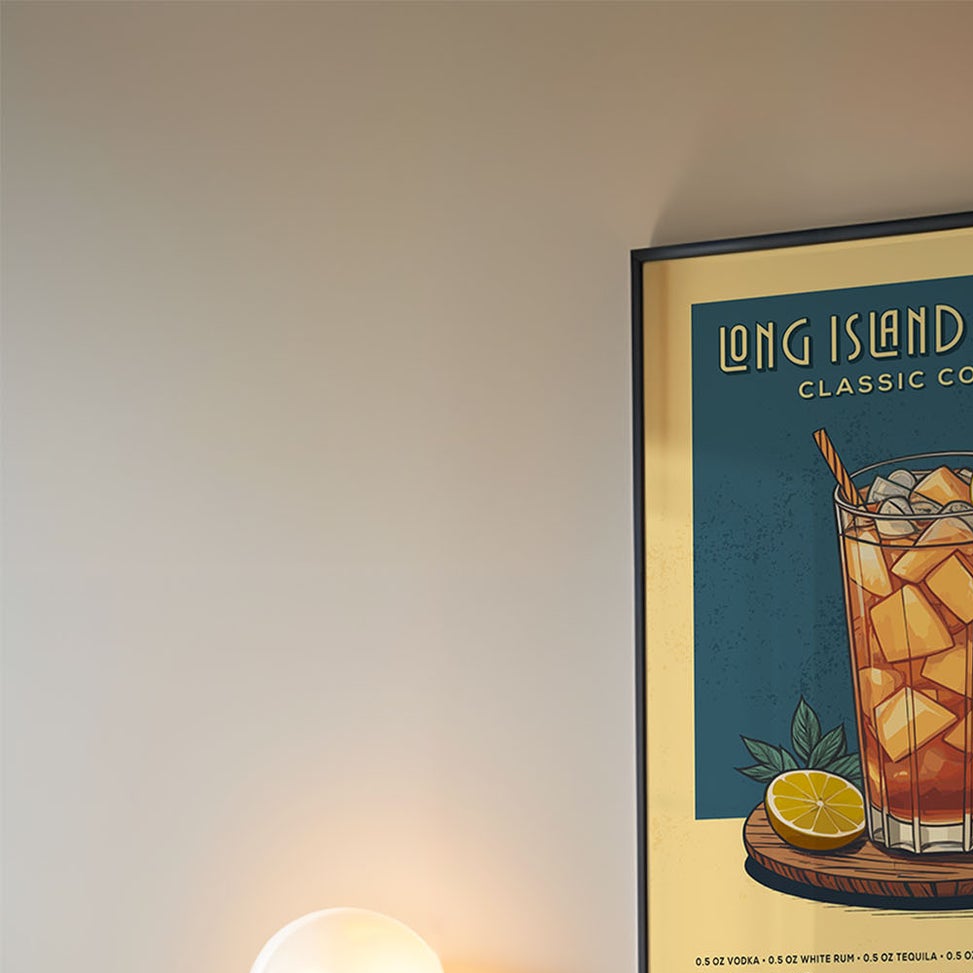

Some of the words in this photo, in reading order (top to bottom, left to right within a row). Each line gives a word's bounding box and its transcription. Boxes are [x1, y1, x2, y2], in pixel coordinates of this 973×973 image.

[720, 317, 810, 373] LONG
[831, 303, 965, 362] ISLAND
[798, 370, 925, 399] CLASSIC
[695, 957, 710, 966] 0.5
[712, 957, 725, 966] OZ
[727, 956, 760, 965] VODKA
[768, 955, 783, 965] 0.5
[785, 955, 798, 964] OZ
[800, 954, 831, 963] WHITE
[833, 954, 854, 963] RUM
[863, 953, 878, 962] 0.5
[881, 953, 893, 962] OZ
[896, 952, 937, 961] TEQUILA
[946, 951, 961, 960] 0.5
